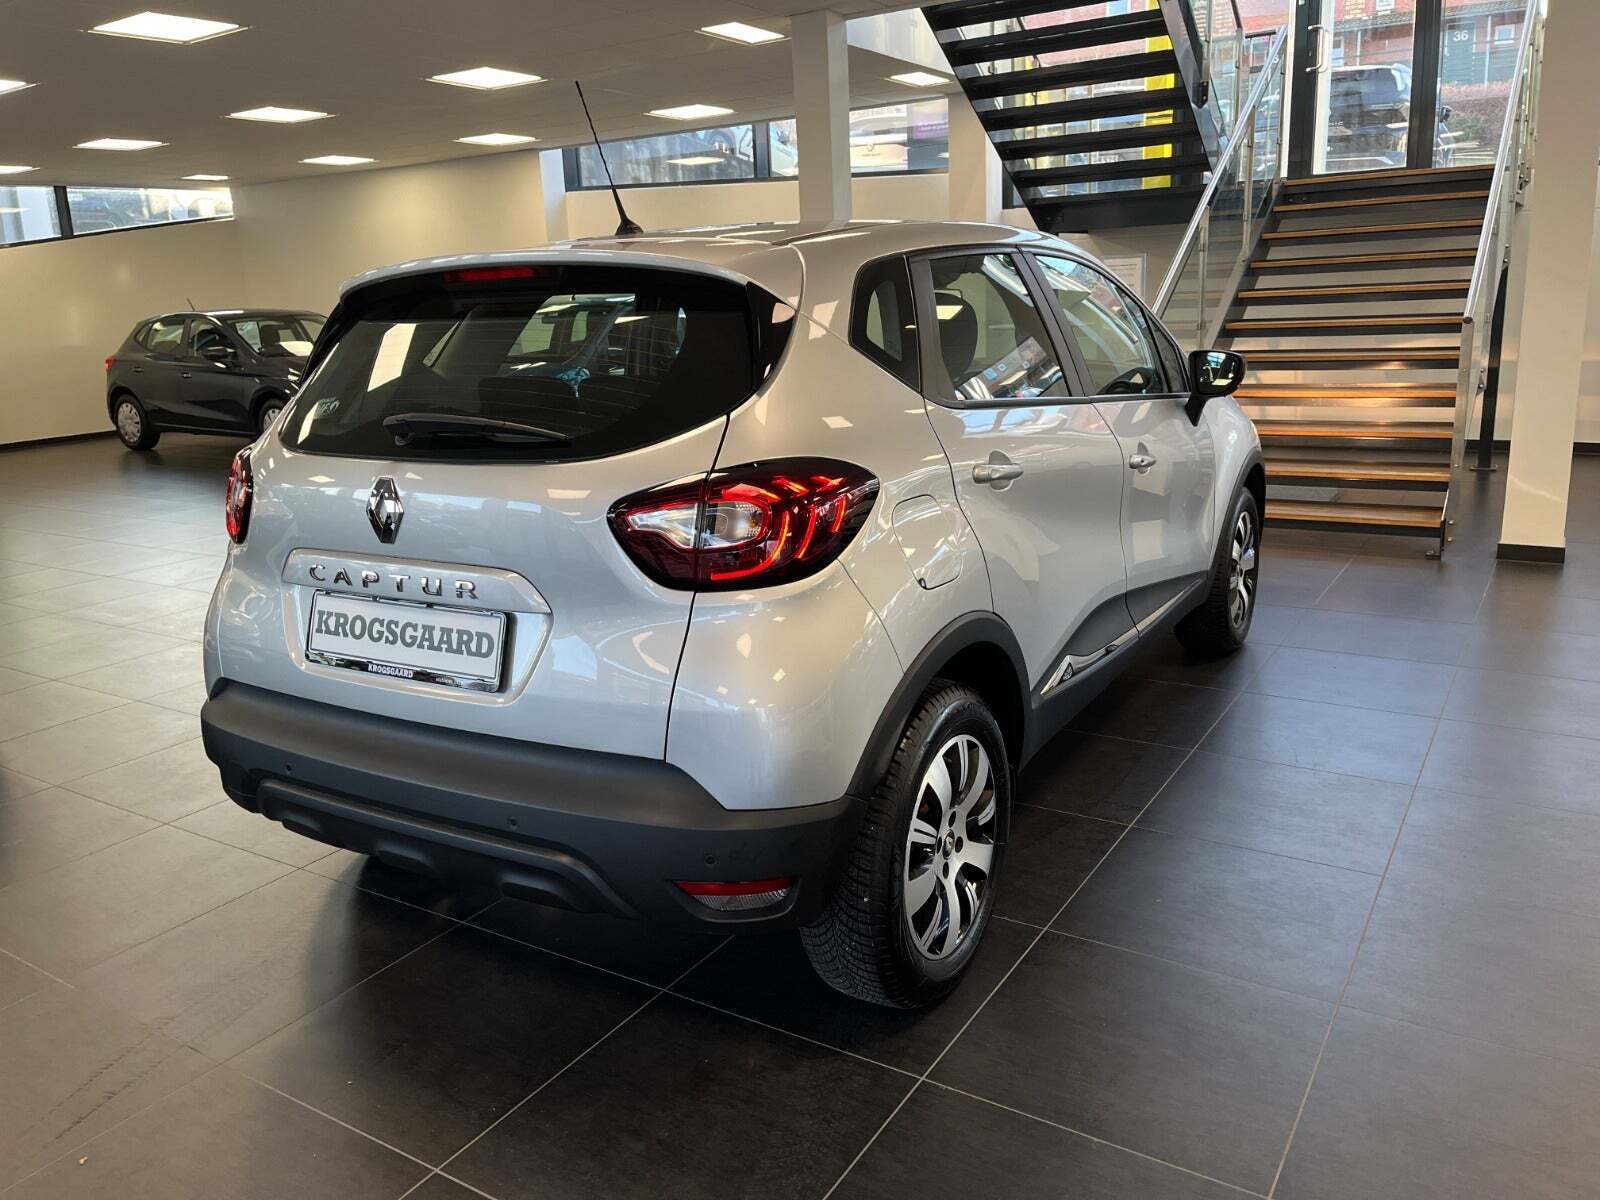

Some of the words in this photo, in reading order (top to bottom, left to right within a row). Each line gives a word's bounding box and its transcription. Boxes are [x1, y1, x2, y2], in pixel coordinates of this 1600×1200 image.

[1453, 30, 1469, 41] 36
[309, 564, 479, 599] CAPTUR
[315, 610, 495, 658] KROGSGAARD
[367, 663, 413, 678] KROGSGAARD
